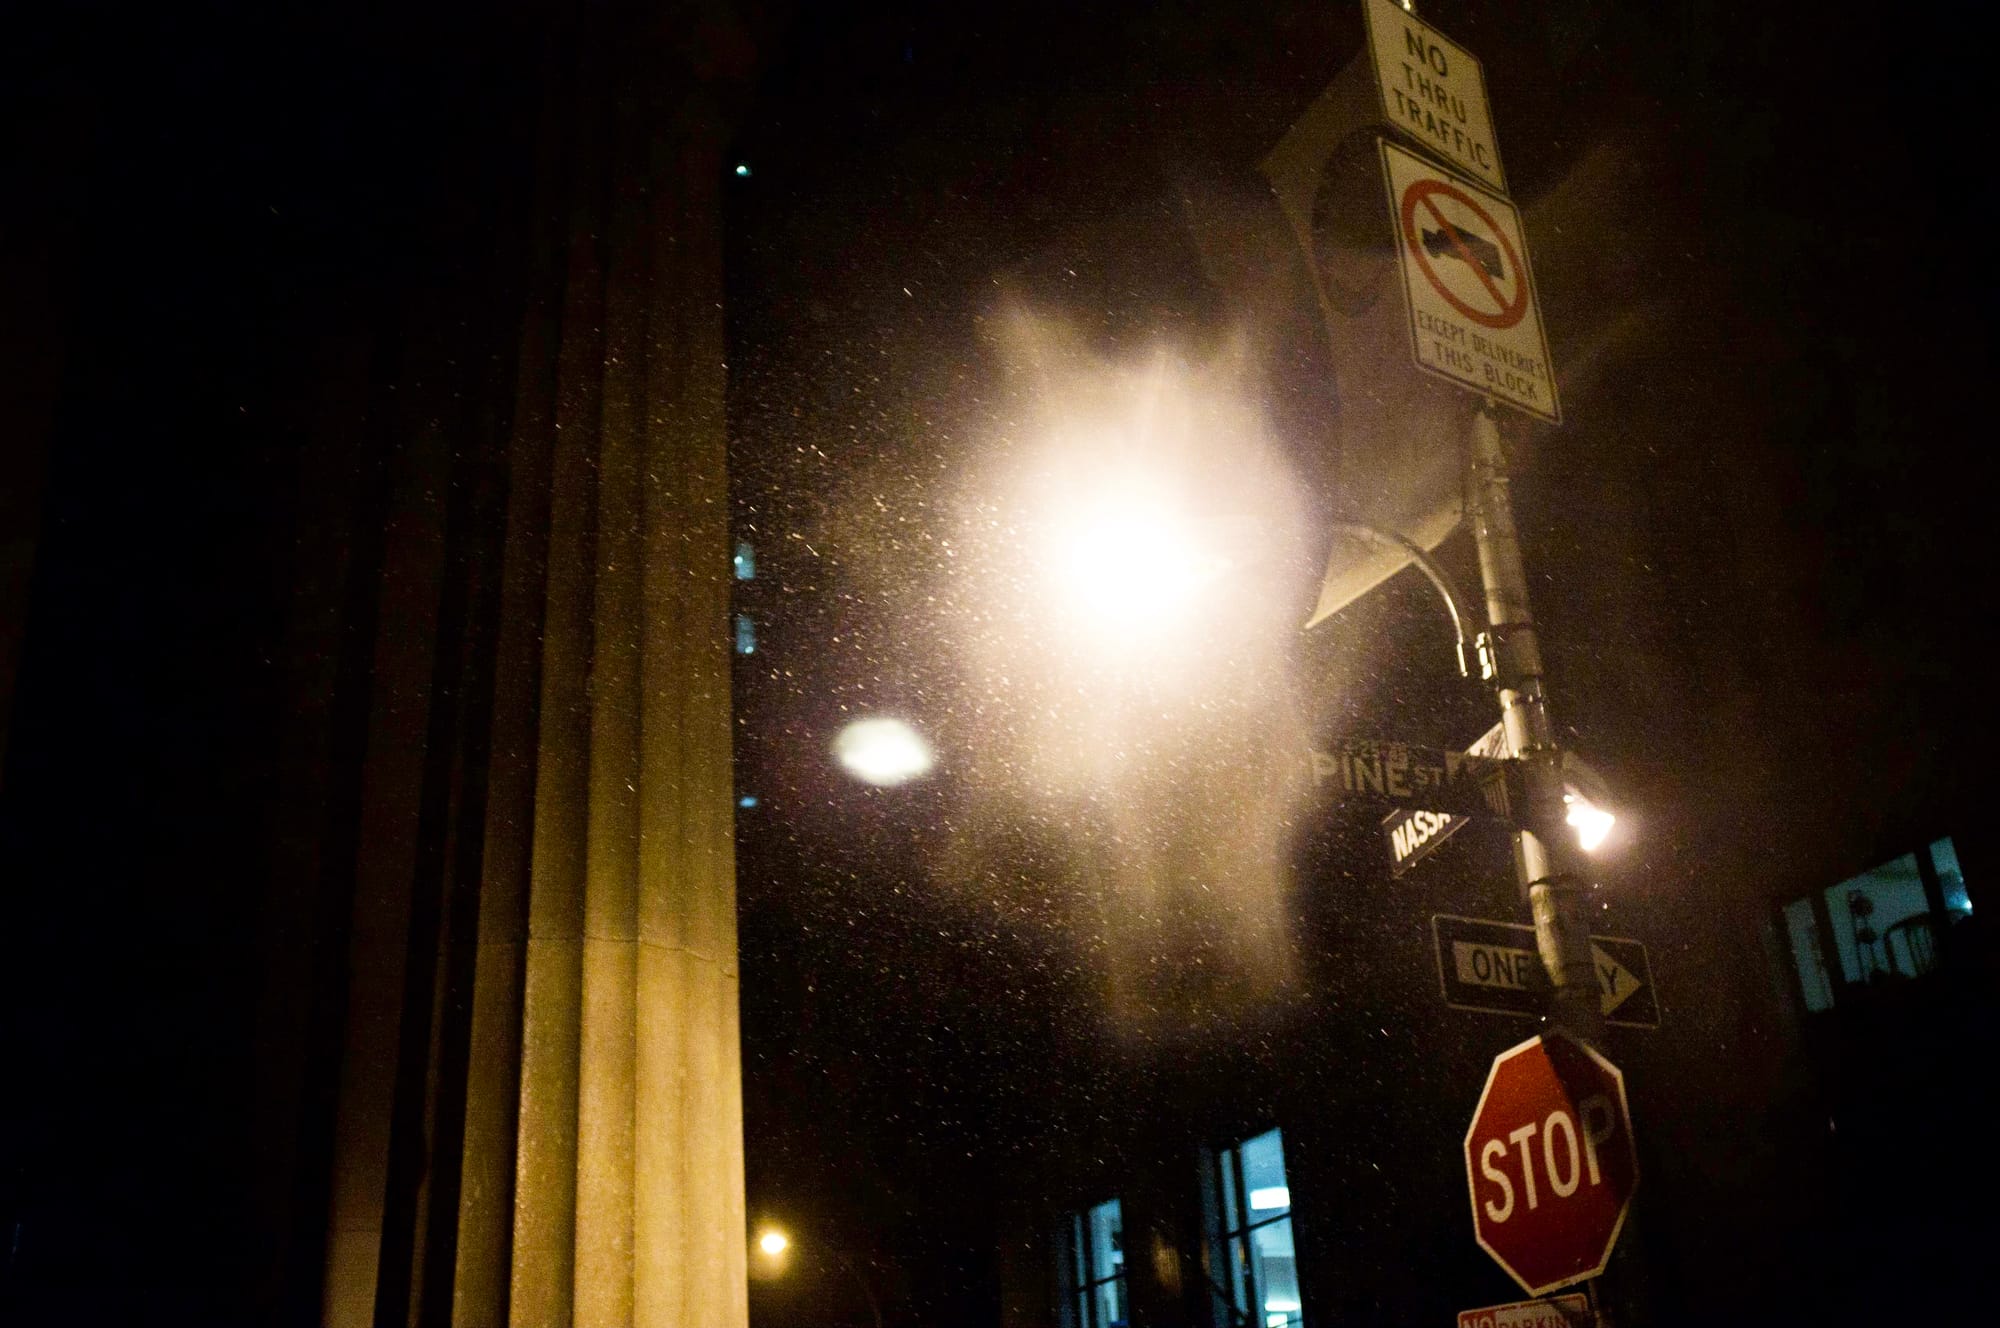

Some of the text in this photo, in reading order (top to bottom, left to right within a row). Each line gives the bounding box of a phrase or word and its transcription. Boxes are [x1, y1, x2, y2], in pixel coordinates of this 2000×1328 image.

[1404, 26, 1448, 78] NO
[1402, 61, 1467, 125] THRU
[1392, 86, 1491, 171] TRAFFIC
[1416, 310, 1465, 345] EXCEPT
[1433, 340, 1538, 401] THIS BLOCK
[1311, 751, 1444, 798] PINE ST
[1480, 1094, 1616, 1224] STOP
